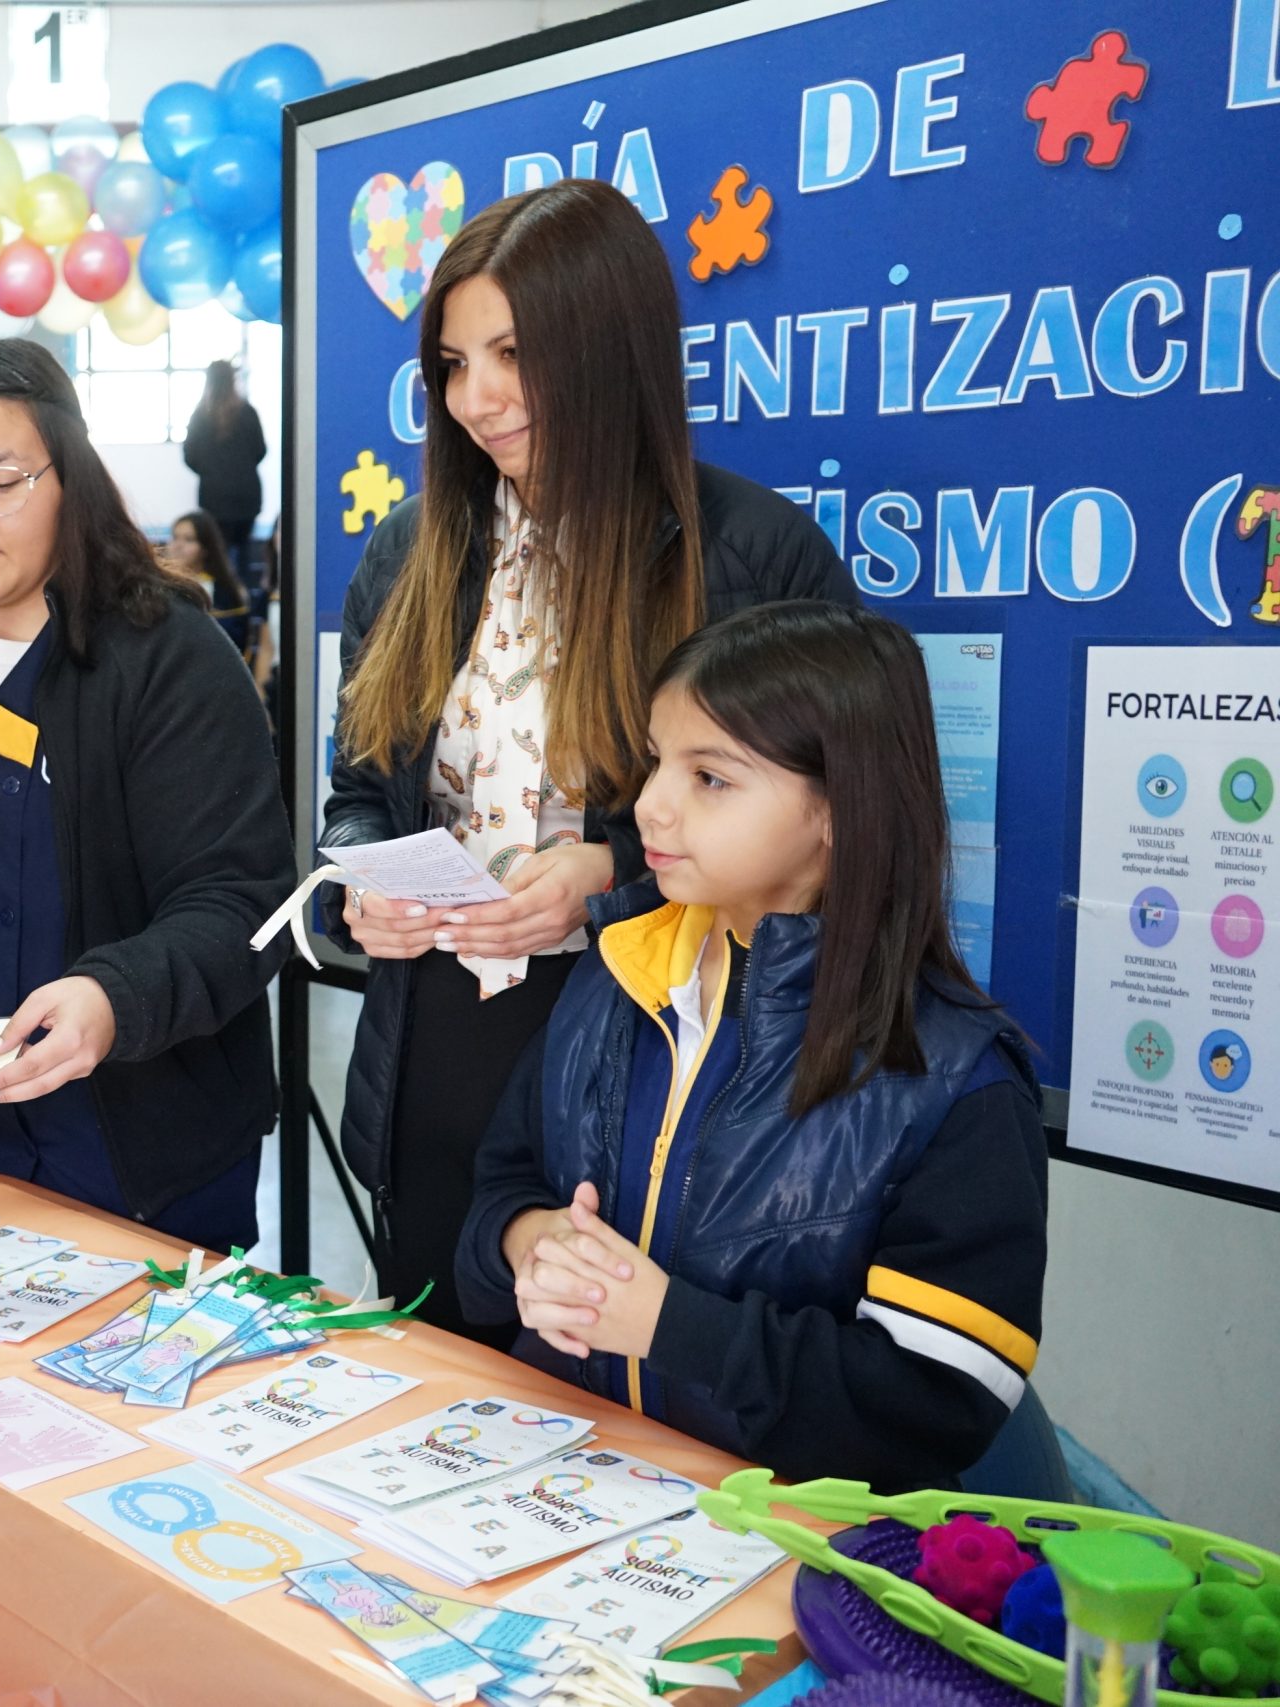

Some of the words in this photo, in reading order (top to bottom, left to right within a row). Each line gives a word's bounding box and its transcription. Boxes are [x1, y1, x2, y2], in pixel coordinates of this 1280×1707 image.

[798, 53, 967, 193] DE
[1129, 824, 1185, 837] HABILIDADES
[1210, 829, 1260, 844] ATENCIÓN
[1261, 834, 1274, 845] AL
[1137, 838, 1176, 850] VISUALES
[1220, 845, 1263, 858] DETALLE
[1122, 851, 1165, 864] aprendizaje
[1122, 863, 1152, 877] enfoque
[1153, 866, 1189, 878] detallado
[1214, 860, 1260, 873] minucioso
[1260, 864, 1267, 875] y
[1223, 876, 1256, 888] preciso
[1124, 955, 1177, 970] EXPERIENCIA
[1210, 963, 1257, 978] MEMORIA
[1125, 969, 1176, 983] conocimiento
[1146, 983, 1190, 998] habilidades
[1212, 978, 1253, 992] excelente
[1127, 993, 1137, 1002] de
[1137, 995, 1152, 1005] alto
[1152, 997, 1171, 1009] nivel
[1209, 992, 1248, 1006] recuerdo
[1247, 997, 1255, 1008] y
[1211, 1006, 1251, 1021] memoria
[1097, 1078, 1131, 1092] ENFOQUE
[1132, 1084, 1174, 1100] PROFUNDO
[1143, 1099, 1178, 1113] capacidad
[1184, 1091, 1234, 1107] PENSAMIENTO
[8, 1288, 69, 1307] AUTISMO
[261, 1392, 310, 1415] SOBRE
[241, 1400, 312, 1430] AUTISMO
[396, 1446, 472, 1475] AUTISMO
[420, 1438, 472, 1462] SOBRE
[471, 1456, 492, 1469] EL
[167, 1486, 207, 1513] INHALA
[526, 1487, 585, 1516] SOBRE
[578, 1511, 602, 1528] EL
[115, 1499, 154, 1527] INHALA
[501, 1494, 580, 1534] AUTISMO
[245, 1529, 292, 1559] EXHALA
[621, 1555, 684, 1580] SOBRE
[685, 1574, 713, 1589] EL
[602, 1567, 695, 1602] AUTISMO
